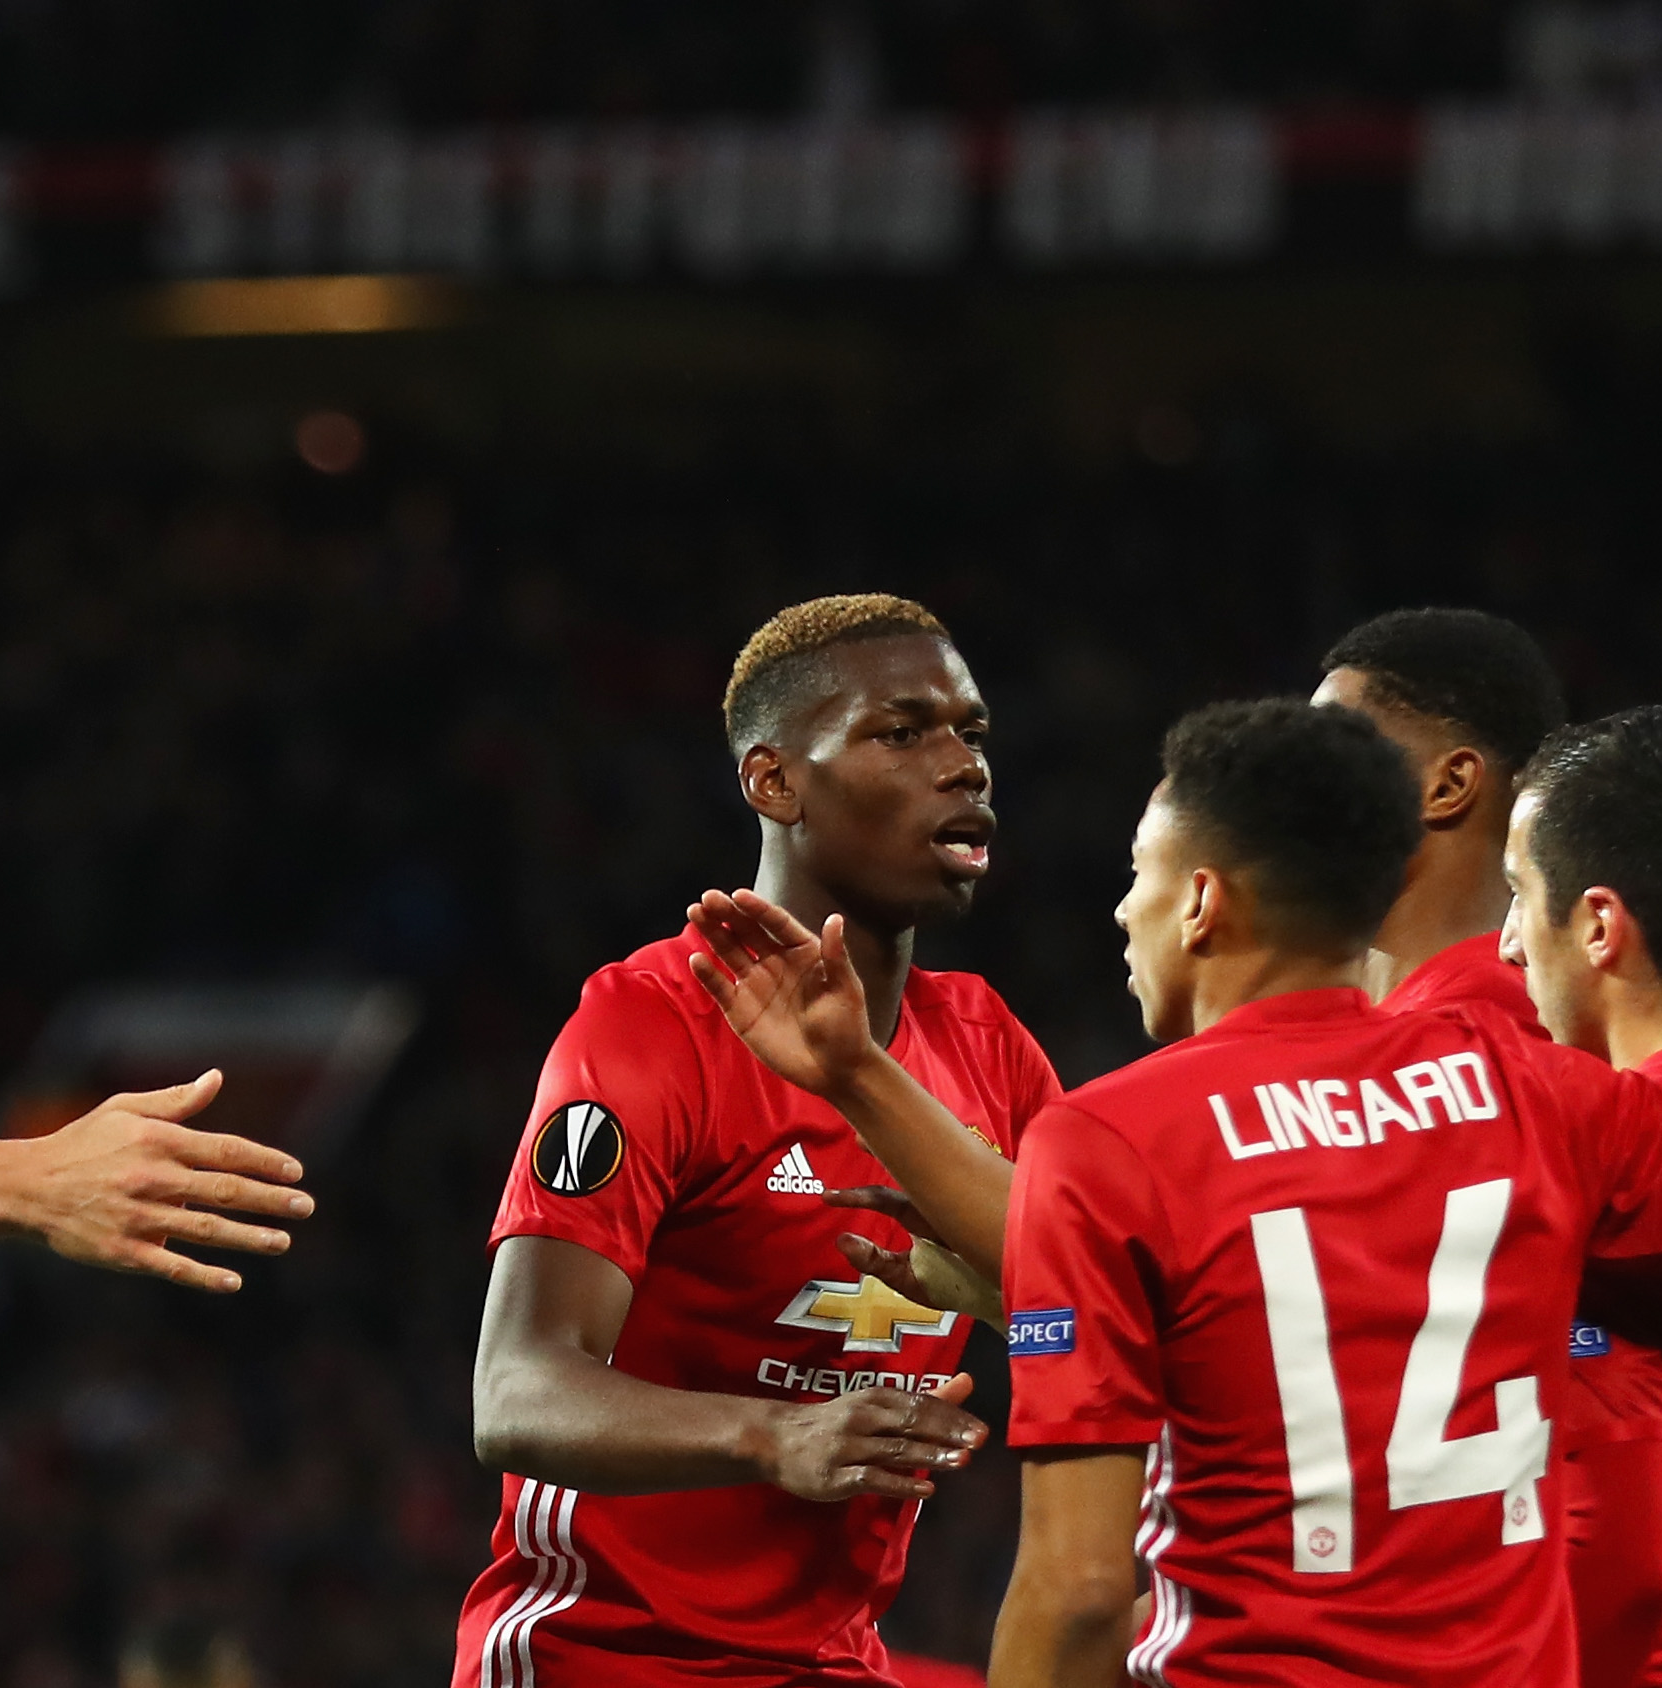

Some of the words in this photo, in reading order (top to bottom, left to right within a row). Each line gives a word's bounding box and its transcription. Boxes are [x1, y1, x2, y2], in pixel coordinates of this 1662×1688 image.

[1208, 1051, 1500, 1160] LINGARD
[767, 1174, 824, 1195] adidas
[1008, 1320, 1074, 1345] SPECT
[1250, 1178, 1551, 1573] 14
